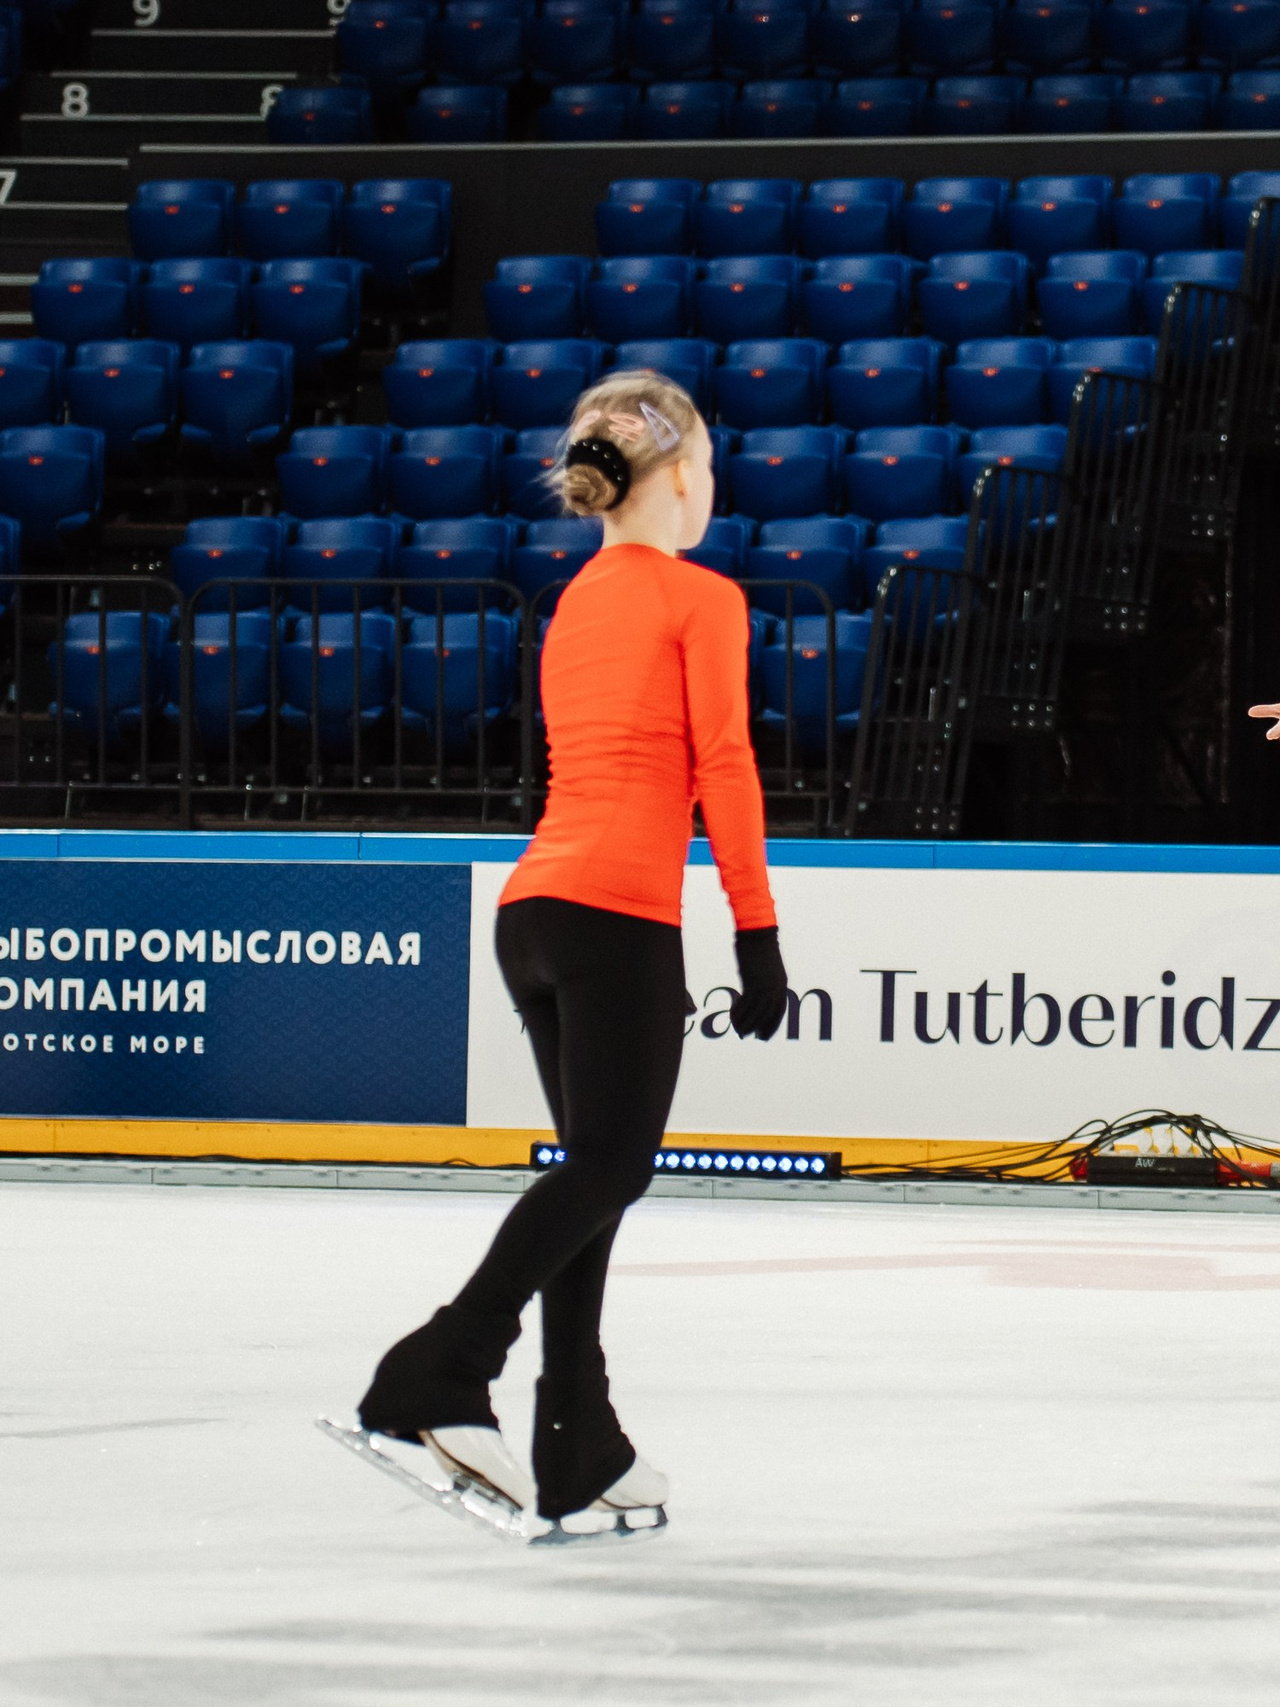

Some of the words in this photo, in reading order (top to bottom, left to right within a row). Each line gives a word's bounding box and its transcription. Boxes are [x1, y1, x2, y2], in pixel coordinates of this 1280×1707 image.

[132, 0, 160, 27] 9
[61, 83, 88, 119] 8
[0, 169, 17, 205] 7
[0, 927, 421, 966] ЫБОПРОМЫСЛОВАЯ
[0, 976, 206, 1013] ОМПАНИЯ
[2, 1033, 113, 1053] ОТСКОЕ
[130, 1035, 204, 1054] МОРЕ
